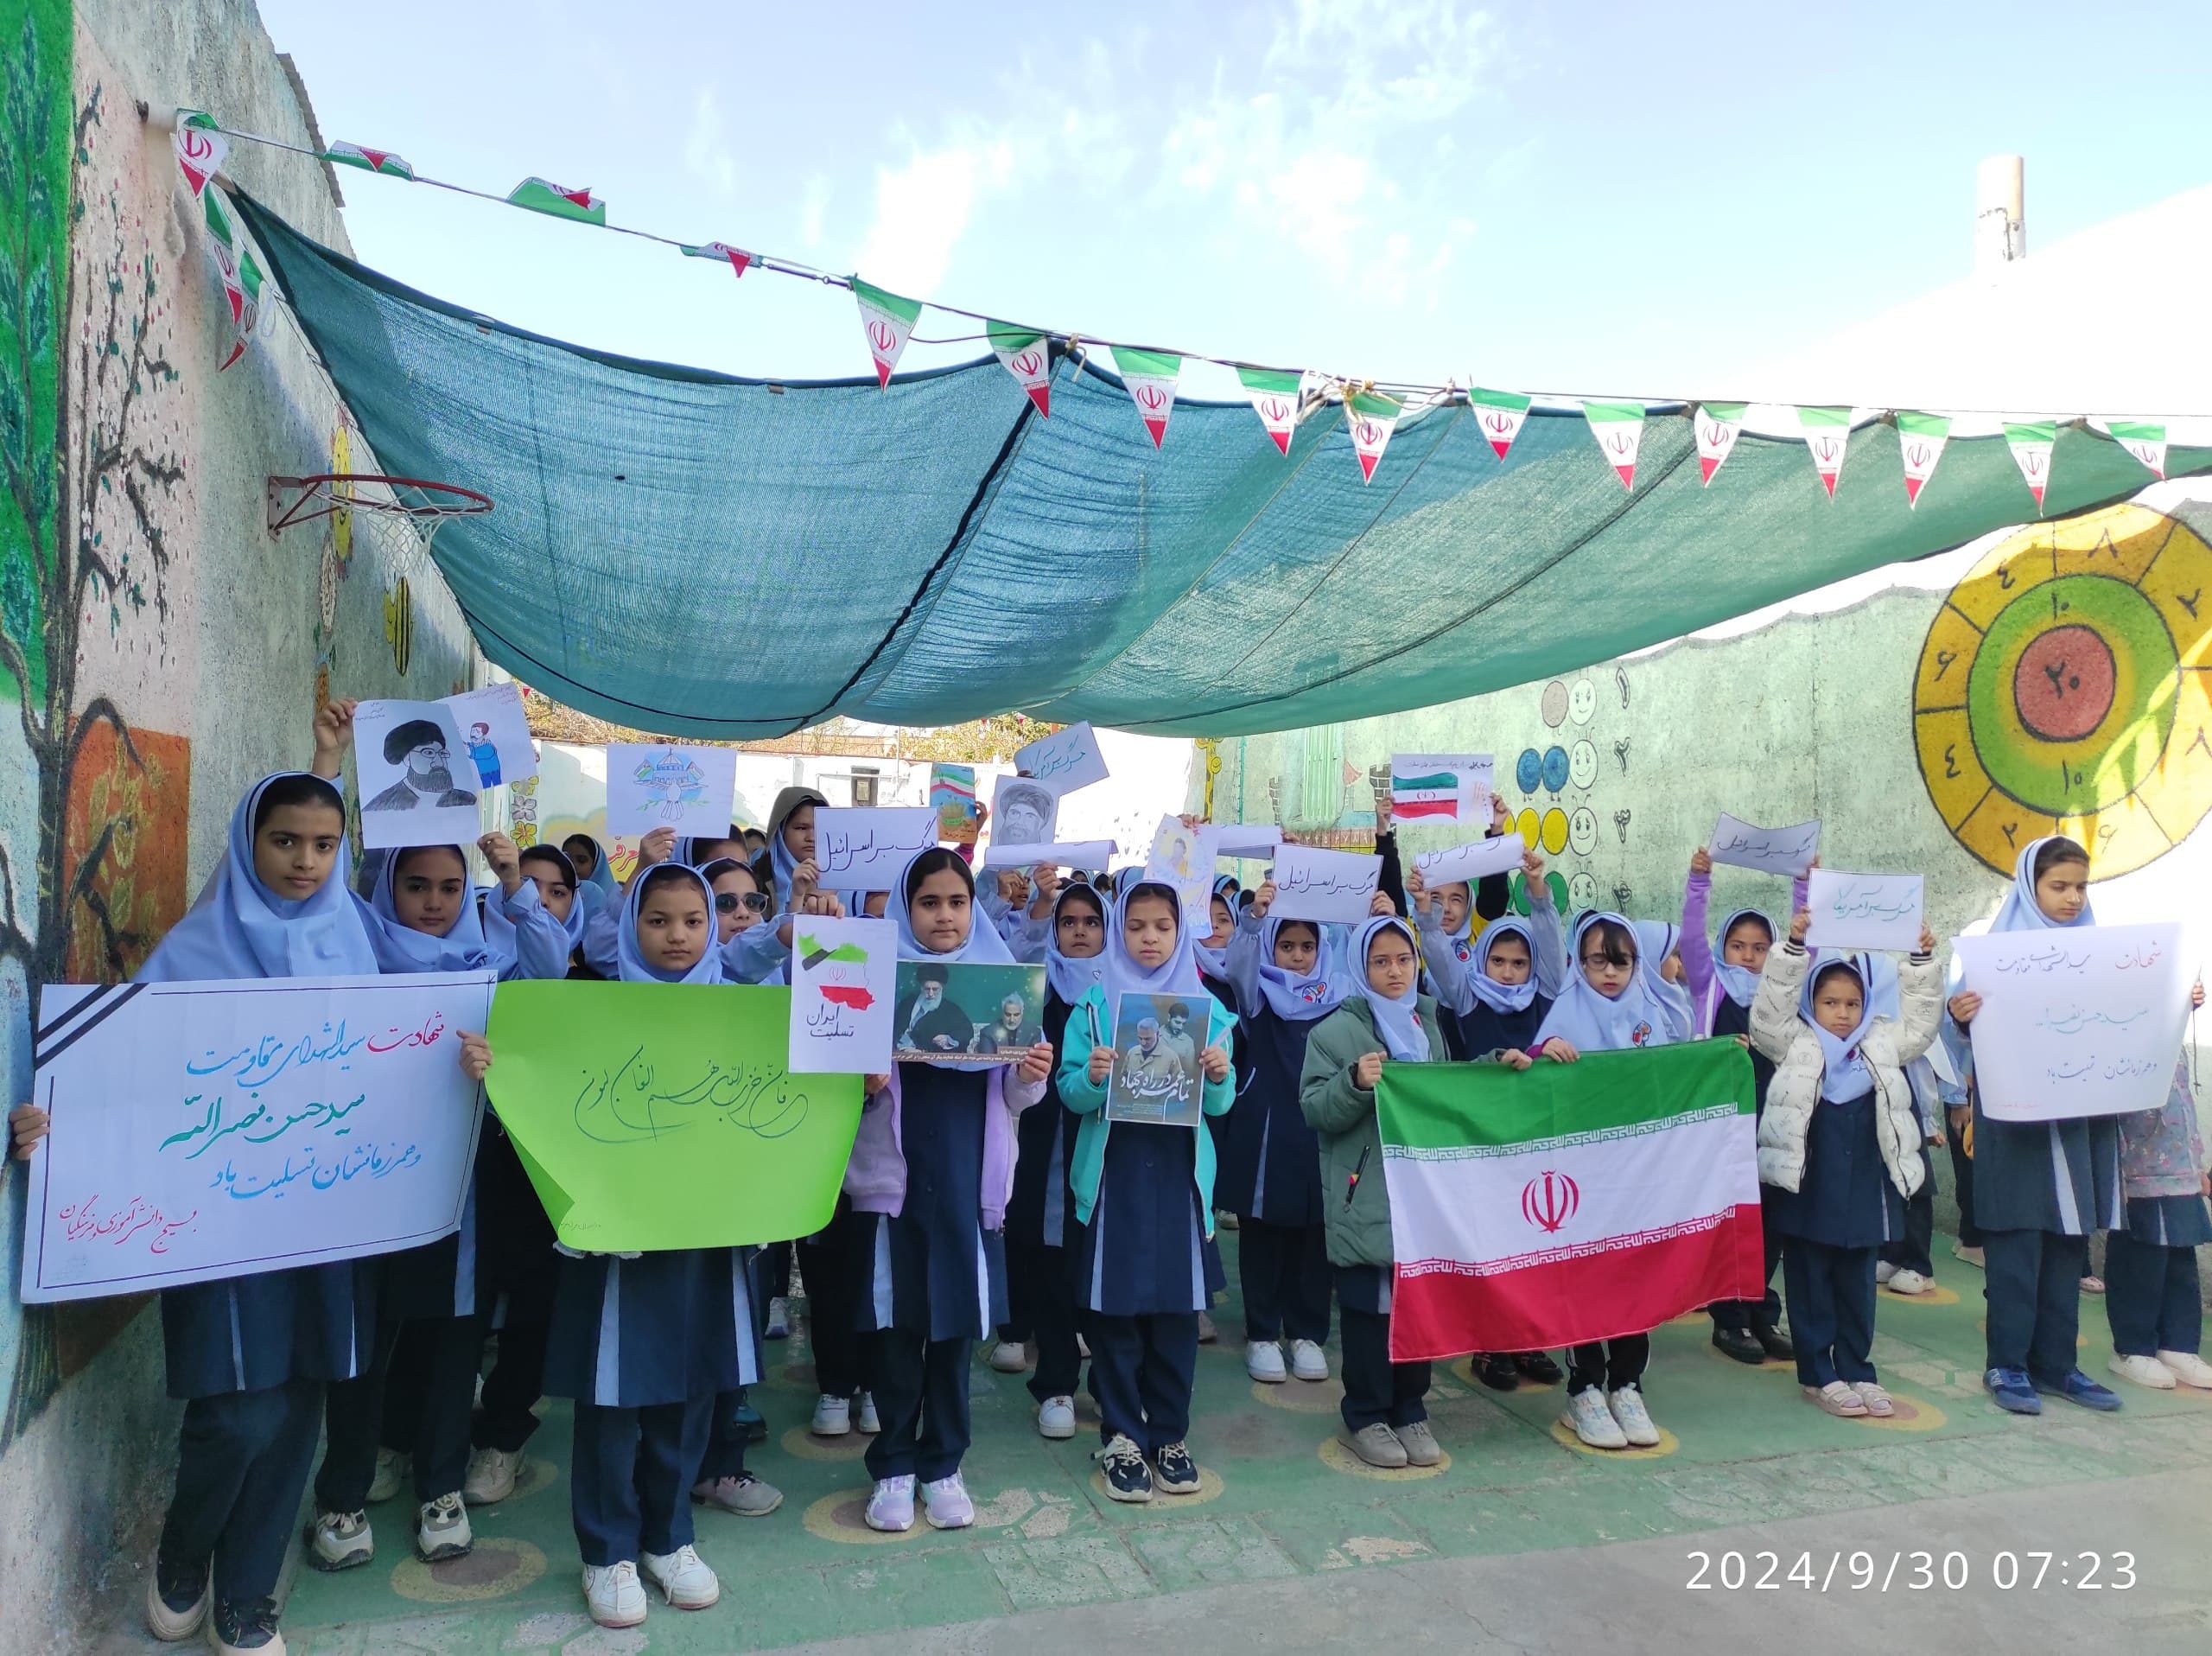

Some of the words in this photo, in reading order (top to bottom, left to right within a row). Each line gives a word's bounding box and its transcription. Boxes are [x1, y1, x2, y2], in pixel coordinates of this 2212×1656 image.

[2088, 528, 2118, 558] ۸
[2045, 661, 2080, 698] ۲۰
[817, 829, 874, 873] اسرائیل
[864, 844, 894, 863] بر
[1278, 865, 1336, 894] اسرائیل
[1326, 883, 1348, 895] بر
[807, 1003, 840, 1026] ایران
[367, 1011, 445, 1053] شهادت
[810, 1021, 854, 1041] تسلیت
[209, 1159, 237, 1191] باد
[230, 1146, 315, 1199] تسلیت
[150, 1209, 197, 1253] بسیج
